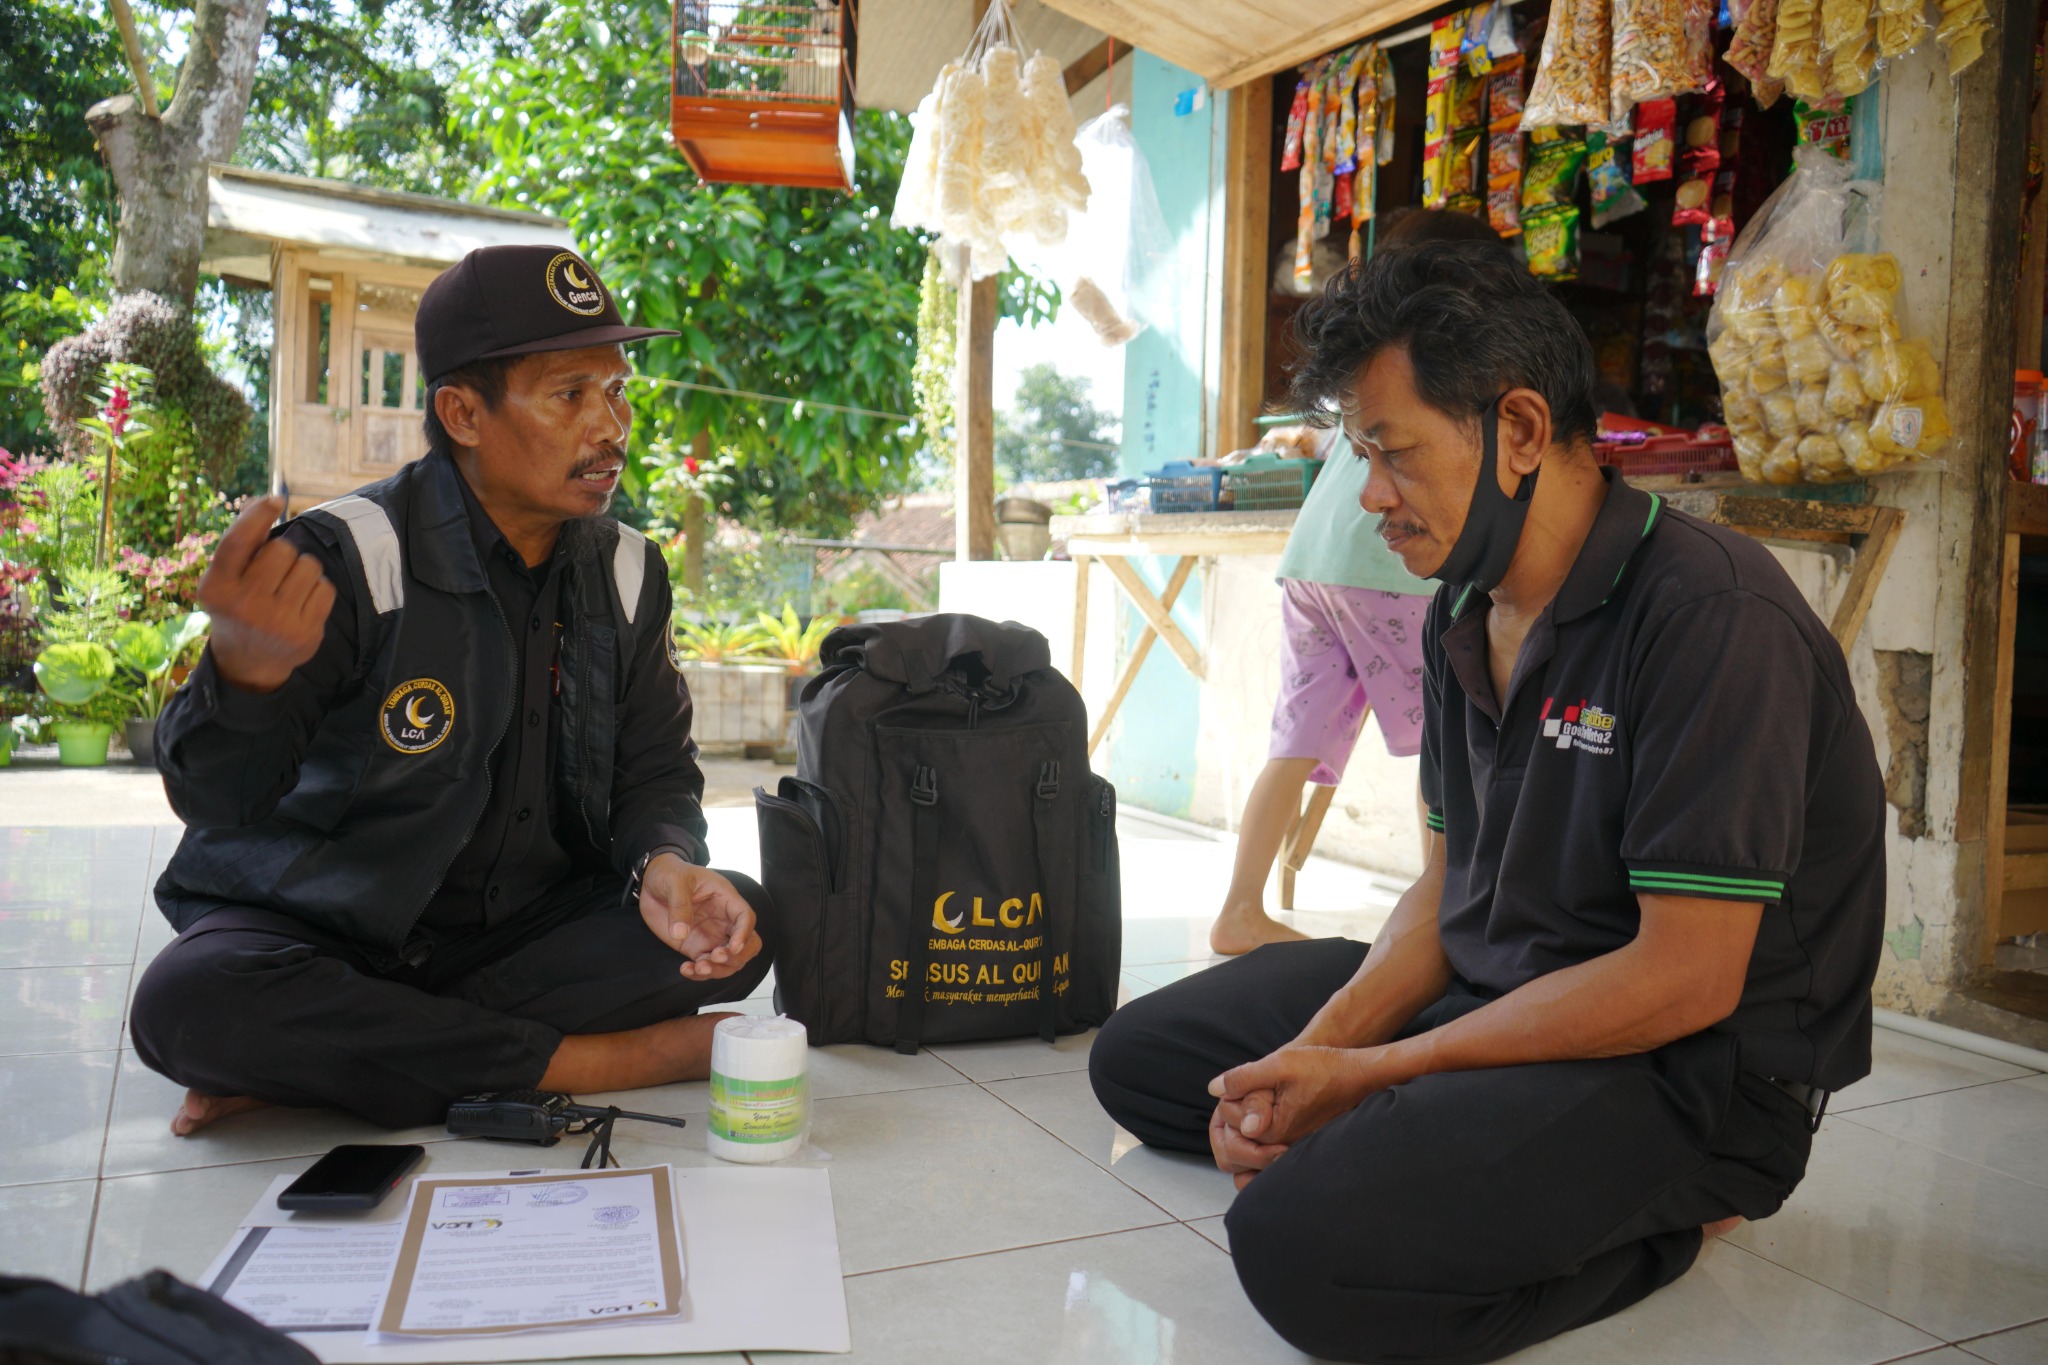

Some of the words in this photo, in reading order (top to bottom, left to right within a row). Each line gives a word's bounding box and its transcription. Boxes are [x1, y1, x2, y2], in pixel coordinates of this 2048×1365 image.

[413, 681, 436, 691] CERDAS
[401, 727, 426, 740] LCA
[972, 892, 1042, 928] LCA
[928, 938, 966, 950] EMBAGA
[968, 938, 1005, 951] CERDAS
[975, 964, 1005, 985] AL
[932, 989, 983, 1005] masyarakat
[986, 985, 1040, 1006] memperhatik
